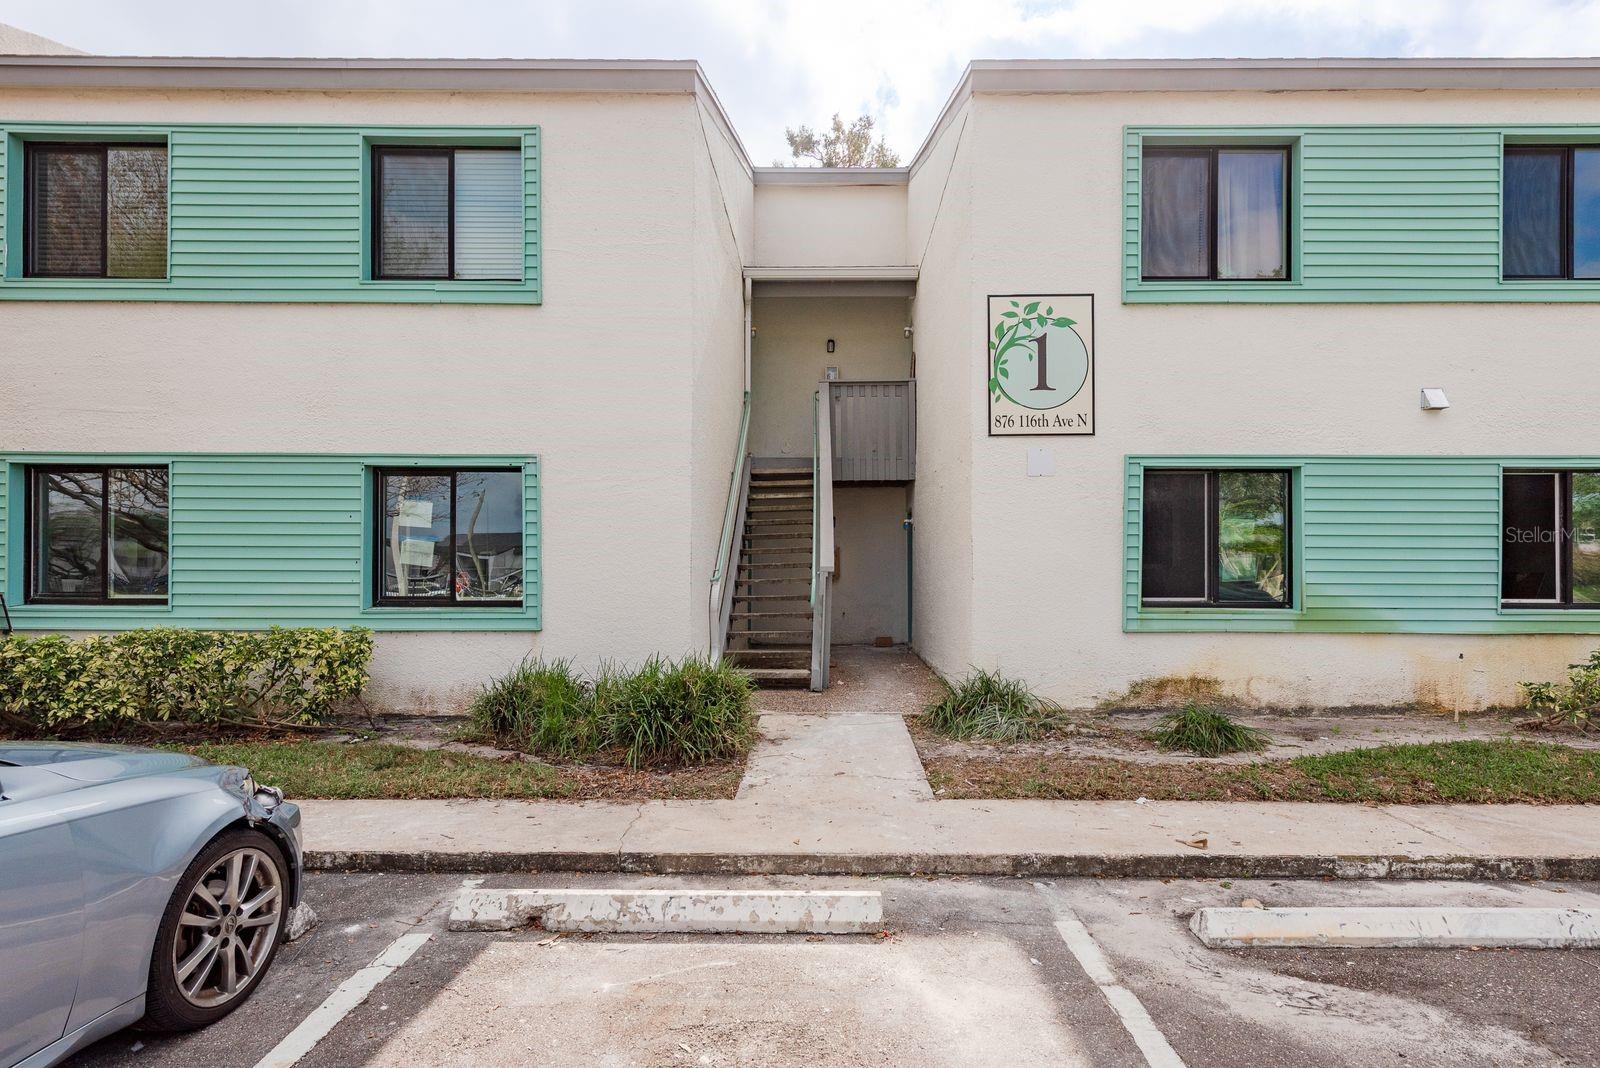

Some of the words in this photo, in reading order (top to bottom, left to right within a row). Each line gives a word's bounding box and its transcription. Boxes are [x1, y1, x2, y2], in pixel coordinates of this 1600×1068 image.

[1028, 332, 1057, 391] 1
[994, 414, 1015, 428] 876
[1019, 413, 1049, 428] 116th
[1052, 414, 1074, 427] Ave
[1077, 413, 1088, 427] N
